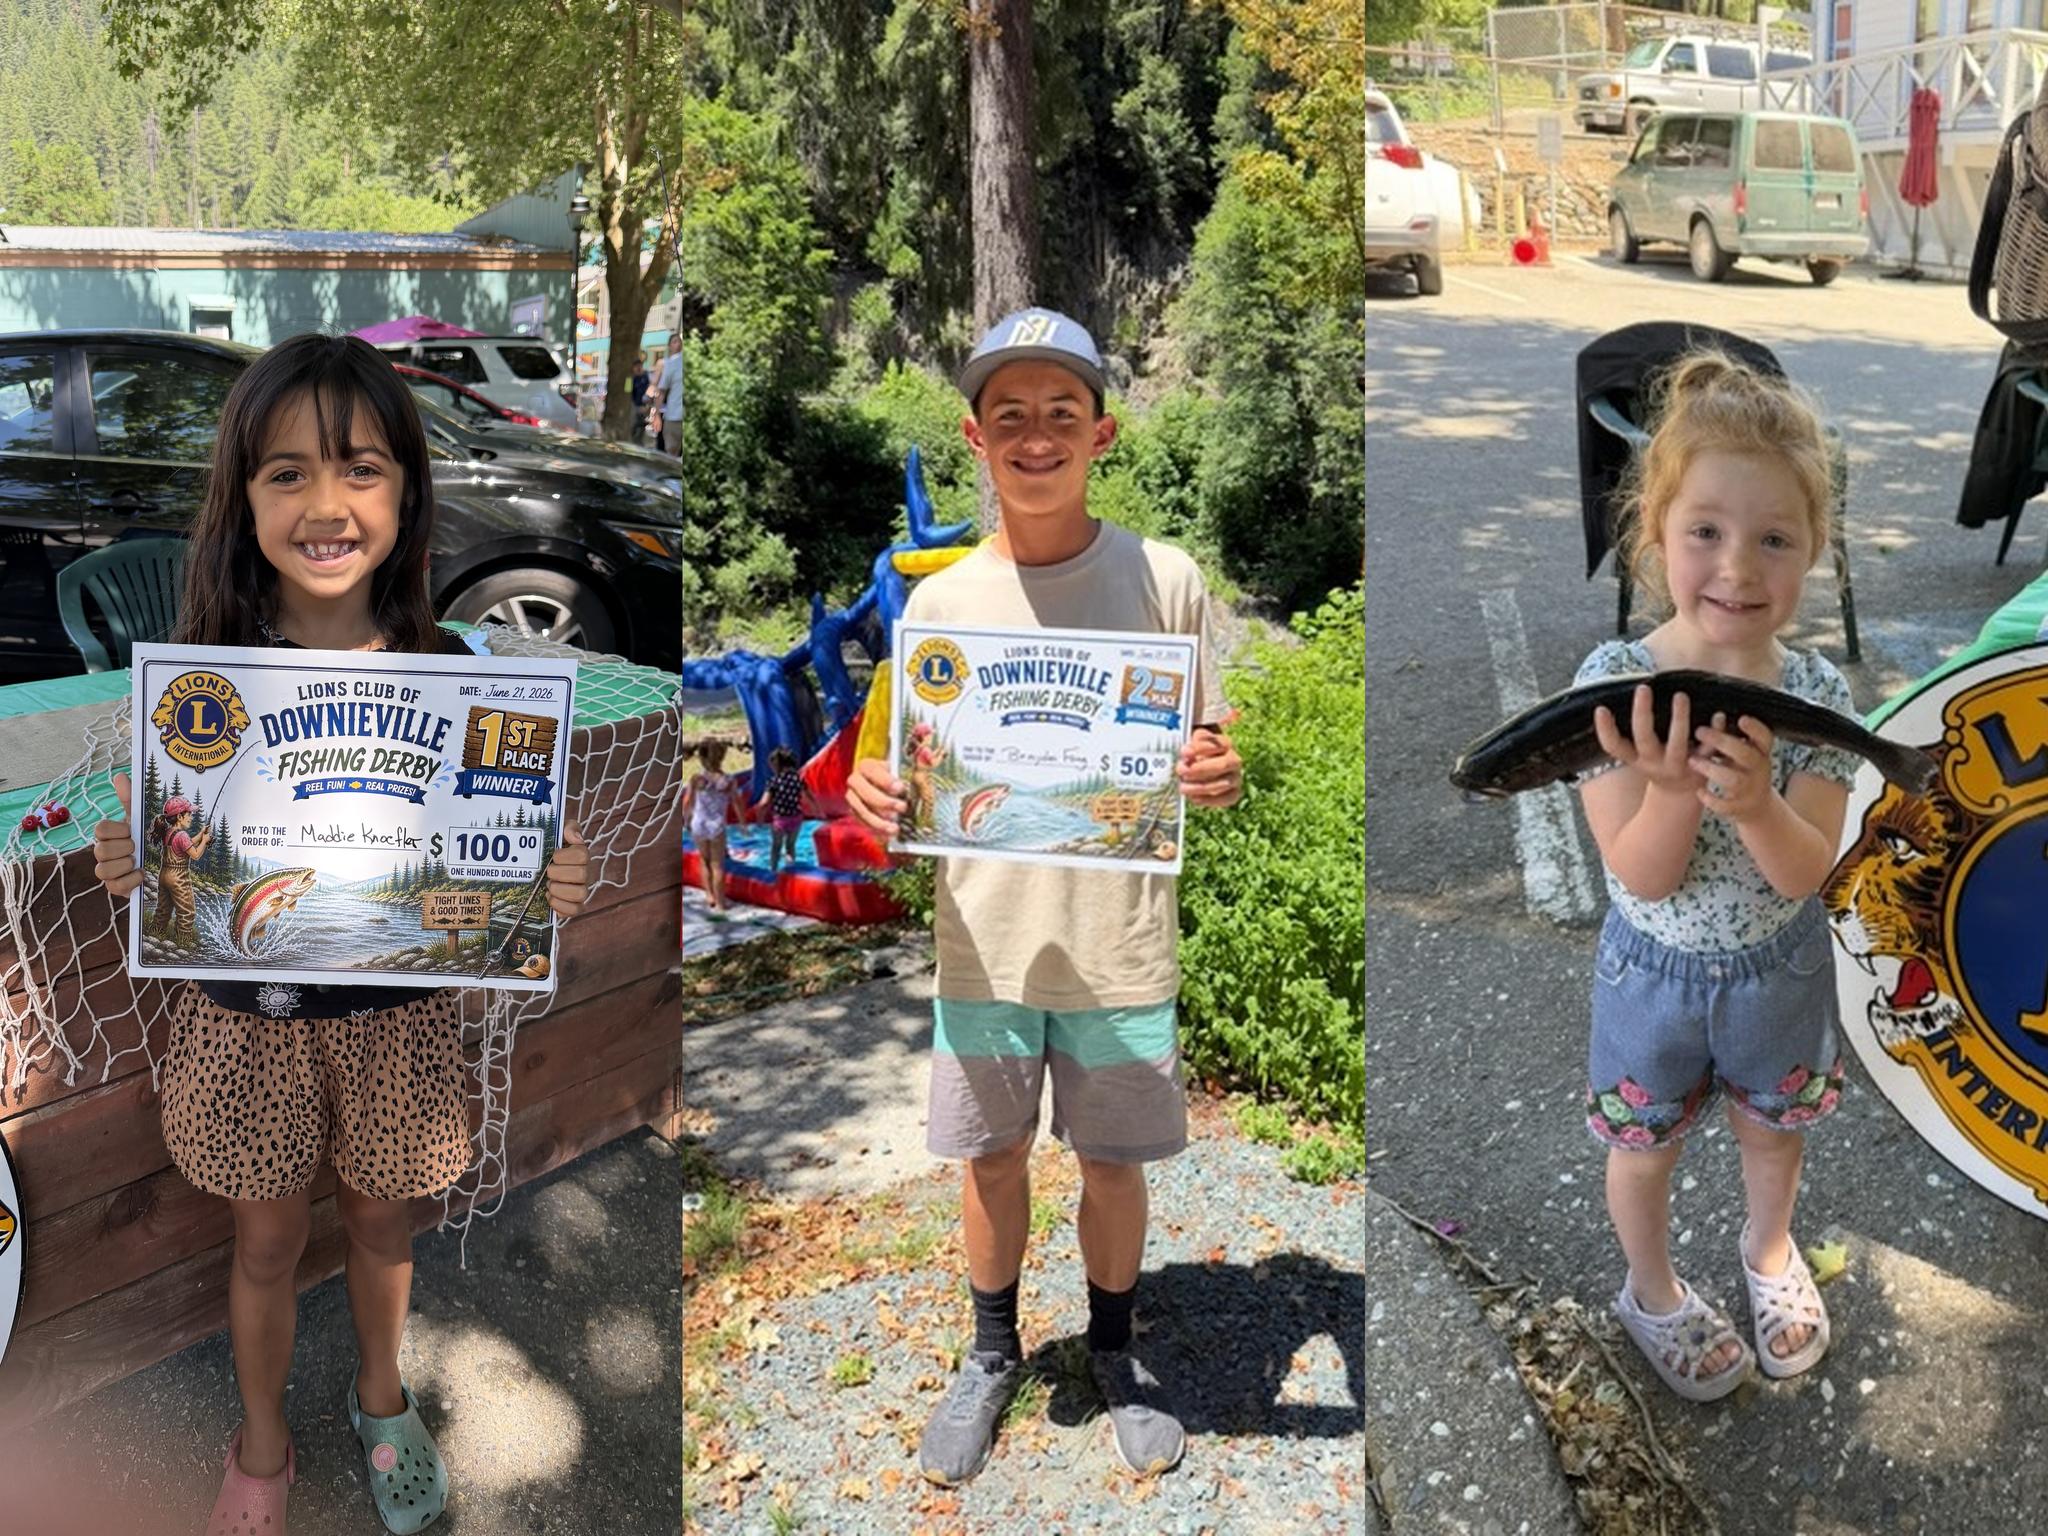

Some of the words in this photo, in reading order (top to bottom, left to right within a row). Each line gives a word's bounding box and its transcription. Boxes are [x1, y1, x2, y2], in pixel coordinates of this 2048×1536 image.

[1004, 645, 1039, 659] LIONS
[1045, 646, 1073, 658] CLUB
[1077, 649, 1092, 661] OF
[930, 657, 949, 682] L
[977, 660, 1113, 696] DOWNIEVILLE
[176, 676, 229, 696] LIONS
[297, 681, 347, 700] LIONS
[353, 681, 395, 699] CLUB
[400, 687, 421, 704] OF
[459, 686, 482, 696] DATE:
[485, 684, 510, 698] June
[512, 687, 525, 699] 21,
[528, 687, 553, 699] 2026
[989, 688, 1049, 712] FISHING
[1051, 690, 1103, 717] DERBY
[190, 701, 217, 734] L
[259, 701, 453, 753] DOWNIEVILLE
[173, 743, 229, 761] INTERNATIONAL
[502, 749, 547, 771] PLACE
[1971, 711, 2048, 789] L
[277, 747, 367, 782] FISHING
[368, 748, 442, 784] DERBY
[1100, 754, 1110, 772] $
[305, 781, 324, 792] REEL
[326, 780, 346, 790] FUN!
[365, 781, 385, 792] REAL
[387, 783, 417, 797] PRIZES!
[472, 774, 539, 795] WINNER!
[242, 826, 256, 835] PAY
[259, 826, 269, 835] TO
[272, 826, 287, 836] THE
[301, 823, 355, 844] Maddie
[242, 836, 268, 846] ORDER
[271, 837, 284, 847] OF:
[429, 832, 443, 858] $
[450, 867, 464, 876] ONE
[466, 868, 500, 877] HUNDRED
[501, 869, 532, 879] DOLLARS
[430, 907, 437, 915] &
[438, 907, 459, 915] GOOD
[460, 906, 484, 915] TIMES!
[434, 896, 457, 905] TIGHT
[459, 896, 481, 905] LINES
